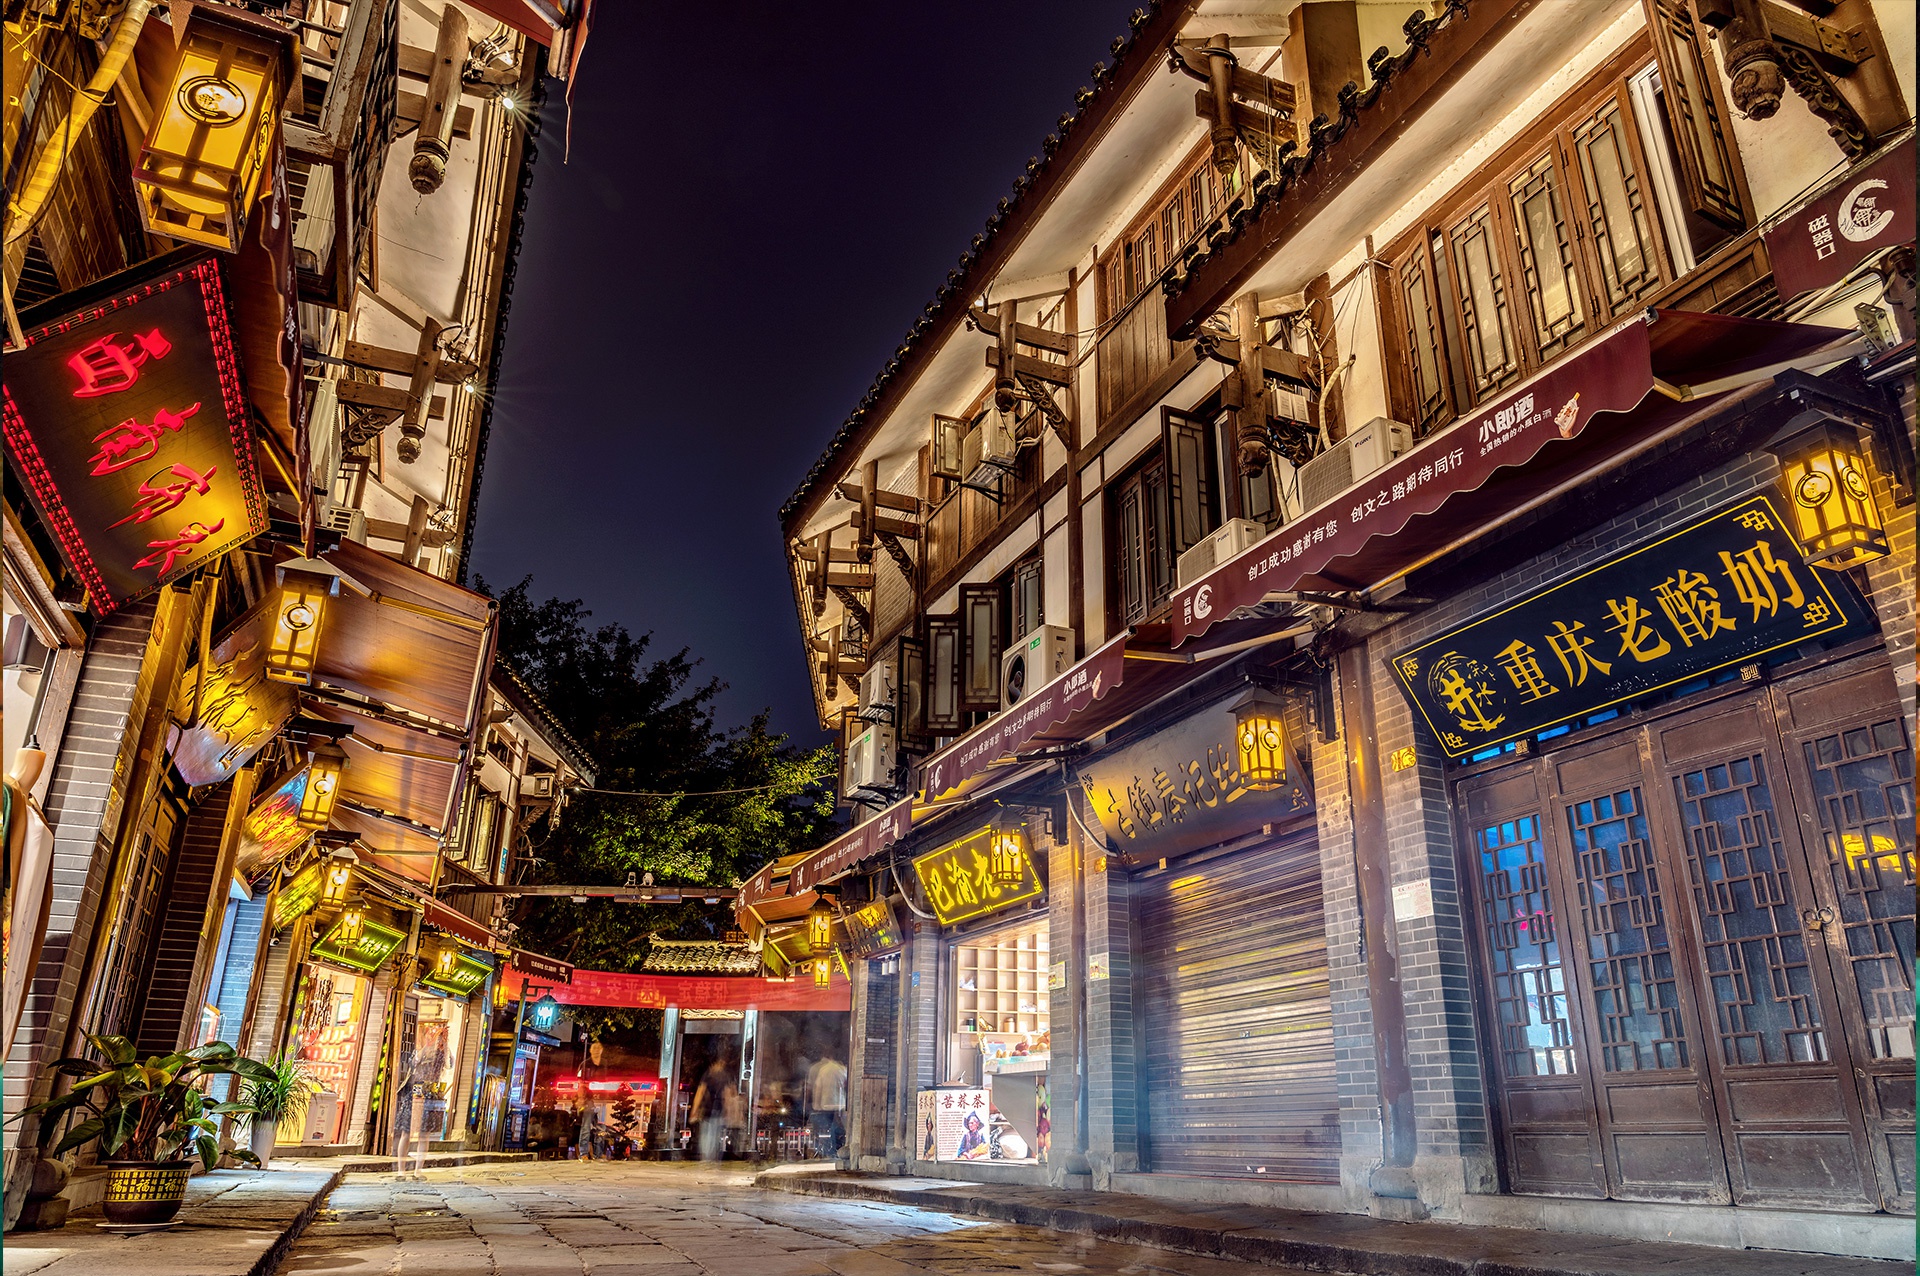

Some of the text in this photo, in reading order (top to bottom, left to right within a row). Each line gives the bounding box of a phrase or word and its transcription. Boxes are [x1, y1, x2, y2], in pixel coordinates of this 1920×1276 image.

[1808, 213, 1836, 261] 磁器口
[1478, 393, 1534, 443] 小郎酒
[1480, 408, 1553, 457] 全国热销的小瓶白酒
[1247, 447, 1464, 581] 创卫成功感谢有您 创文之路期待同行
[1494, 540, 1806, 706] 重庆老酸奶
[930, 848, 1018, 912] 巴渝老
[941, 1093, 985, 1109] 苦荞茶
[136, 1178, 150, 1192] 福
